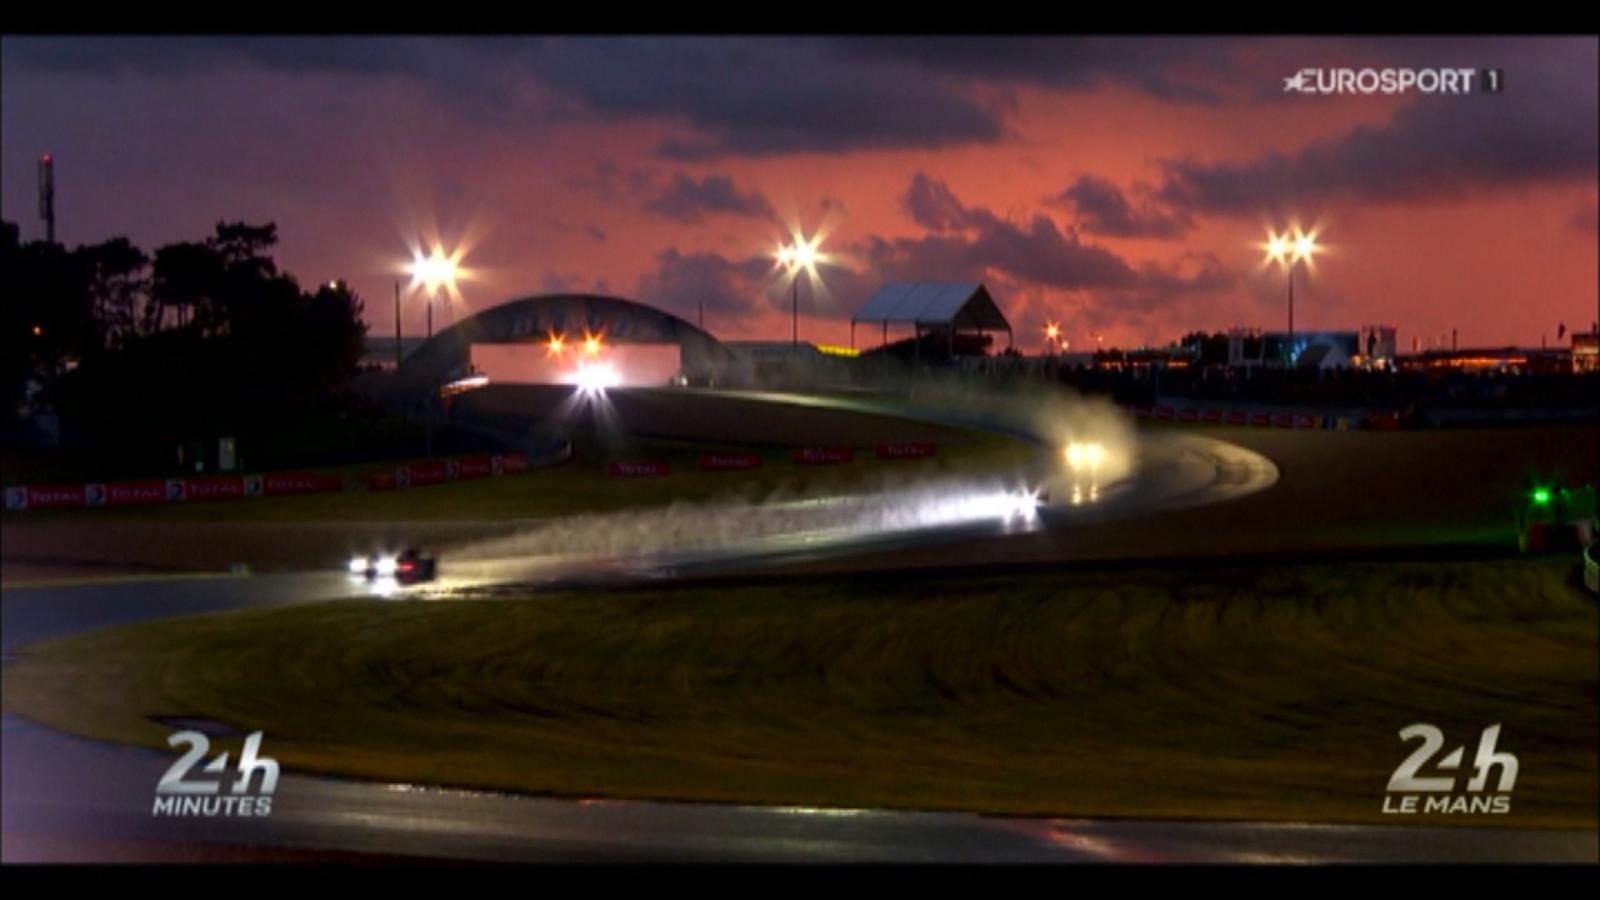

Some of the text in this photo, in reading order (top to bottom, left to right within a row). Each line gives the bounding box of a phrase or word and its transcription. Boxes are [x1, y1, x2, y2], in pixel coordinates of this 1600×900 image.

[110, 487, 160, 498] TOTAL
[190, 482, 242, 495] TOTAL
[30, 490, 80, 502] TOTAL
